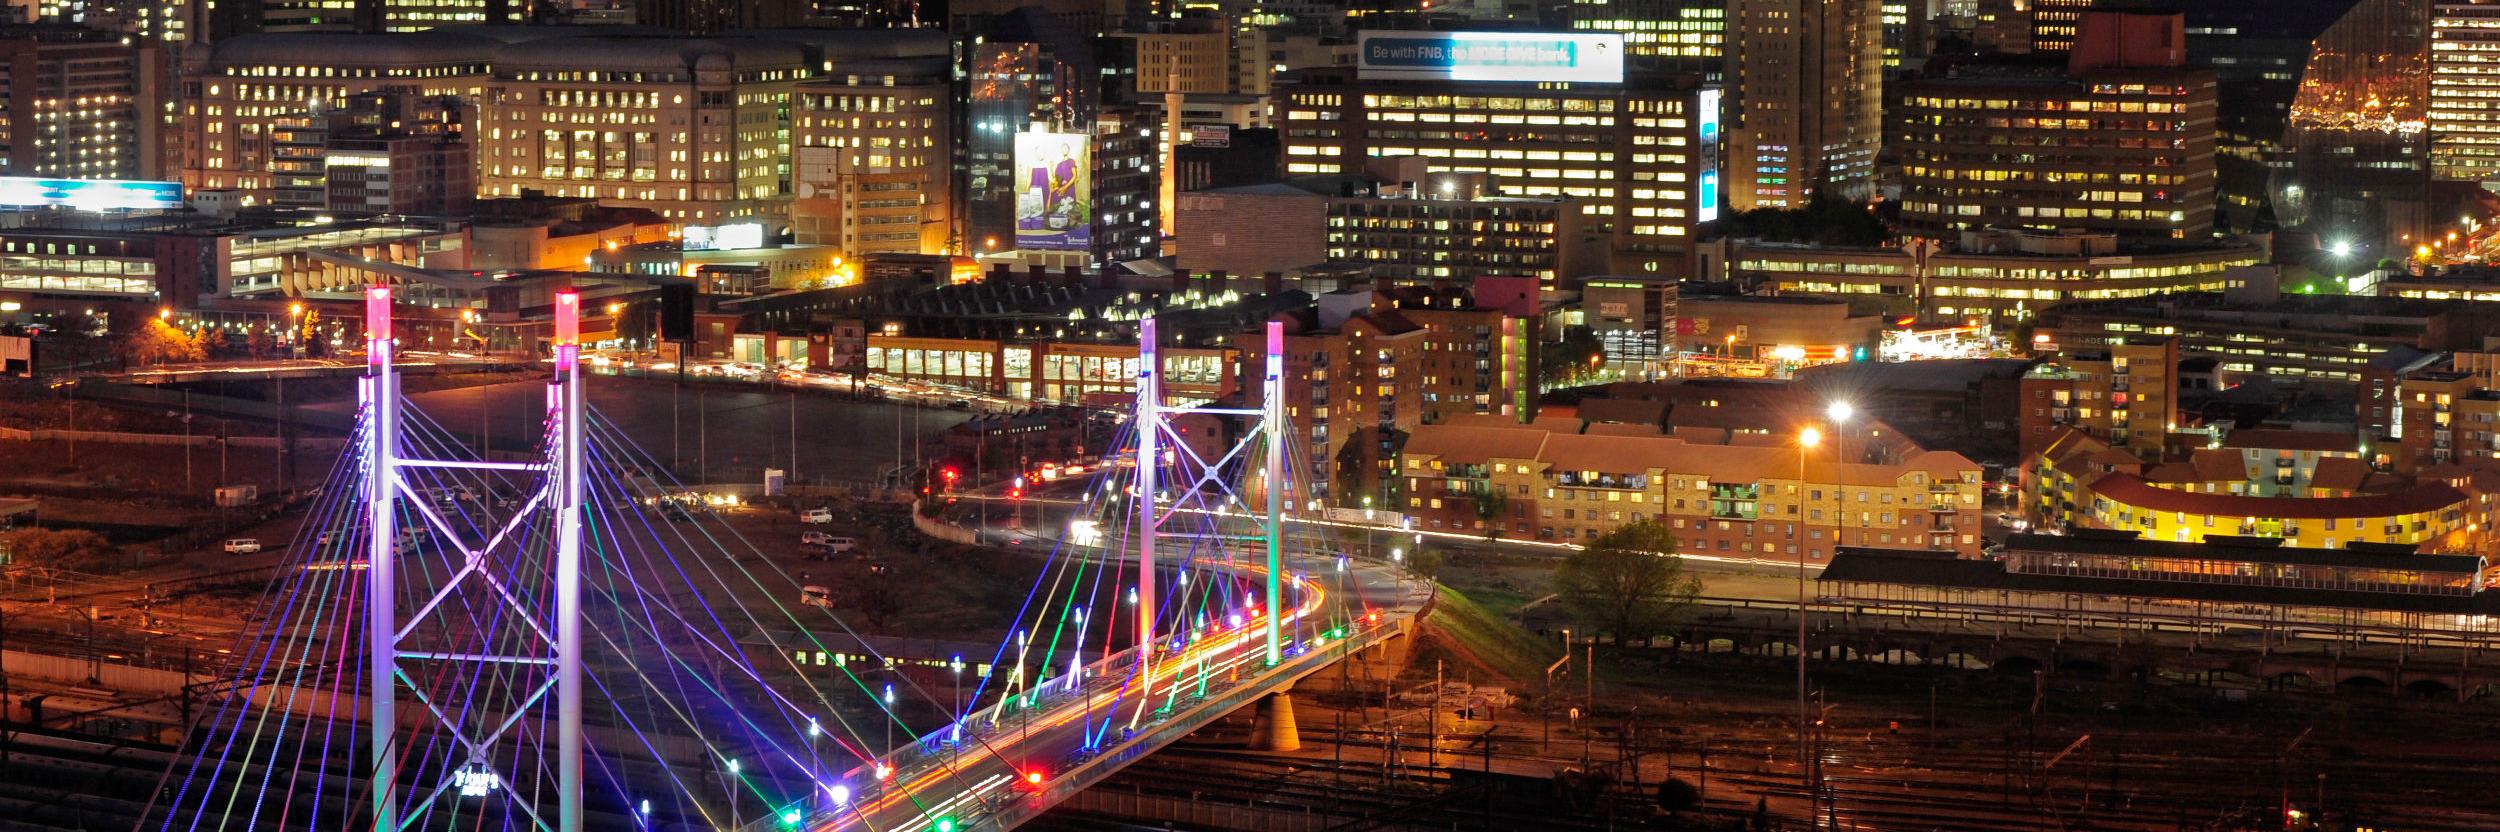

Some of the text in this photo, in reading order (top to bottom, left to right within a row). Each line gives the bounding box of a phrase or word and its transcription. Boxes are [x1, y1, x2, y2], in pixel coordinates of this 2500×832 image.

[1373, 46, 1389, 59] Be
[1391, 44, 1416, 59] with
[1417, 46, 1445, 61] FNB,
